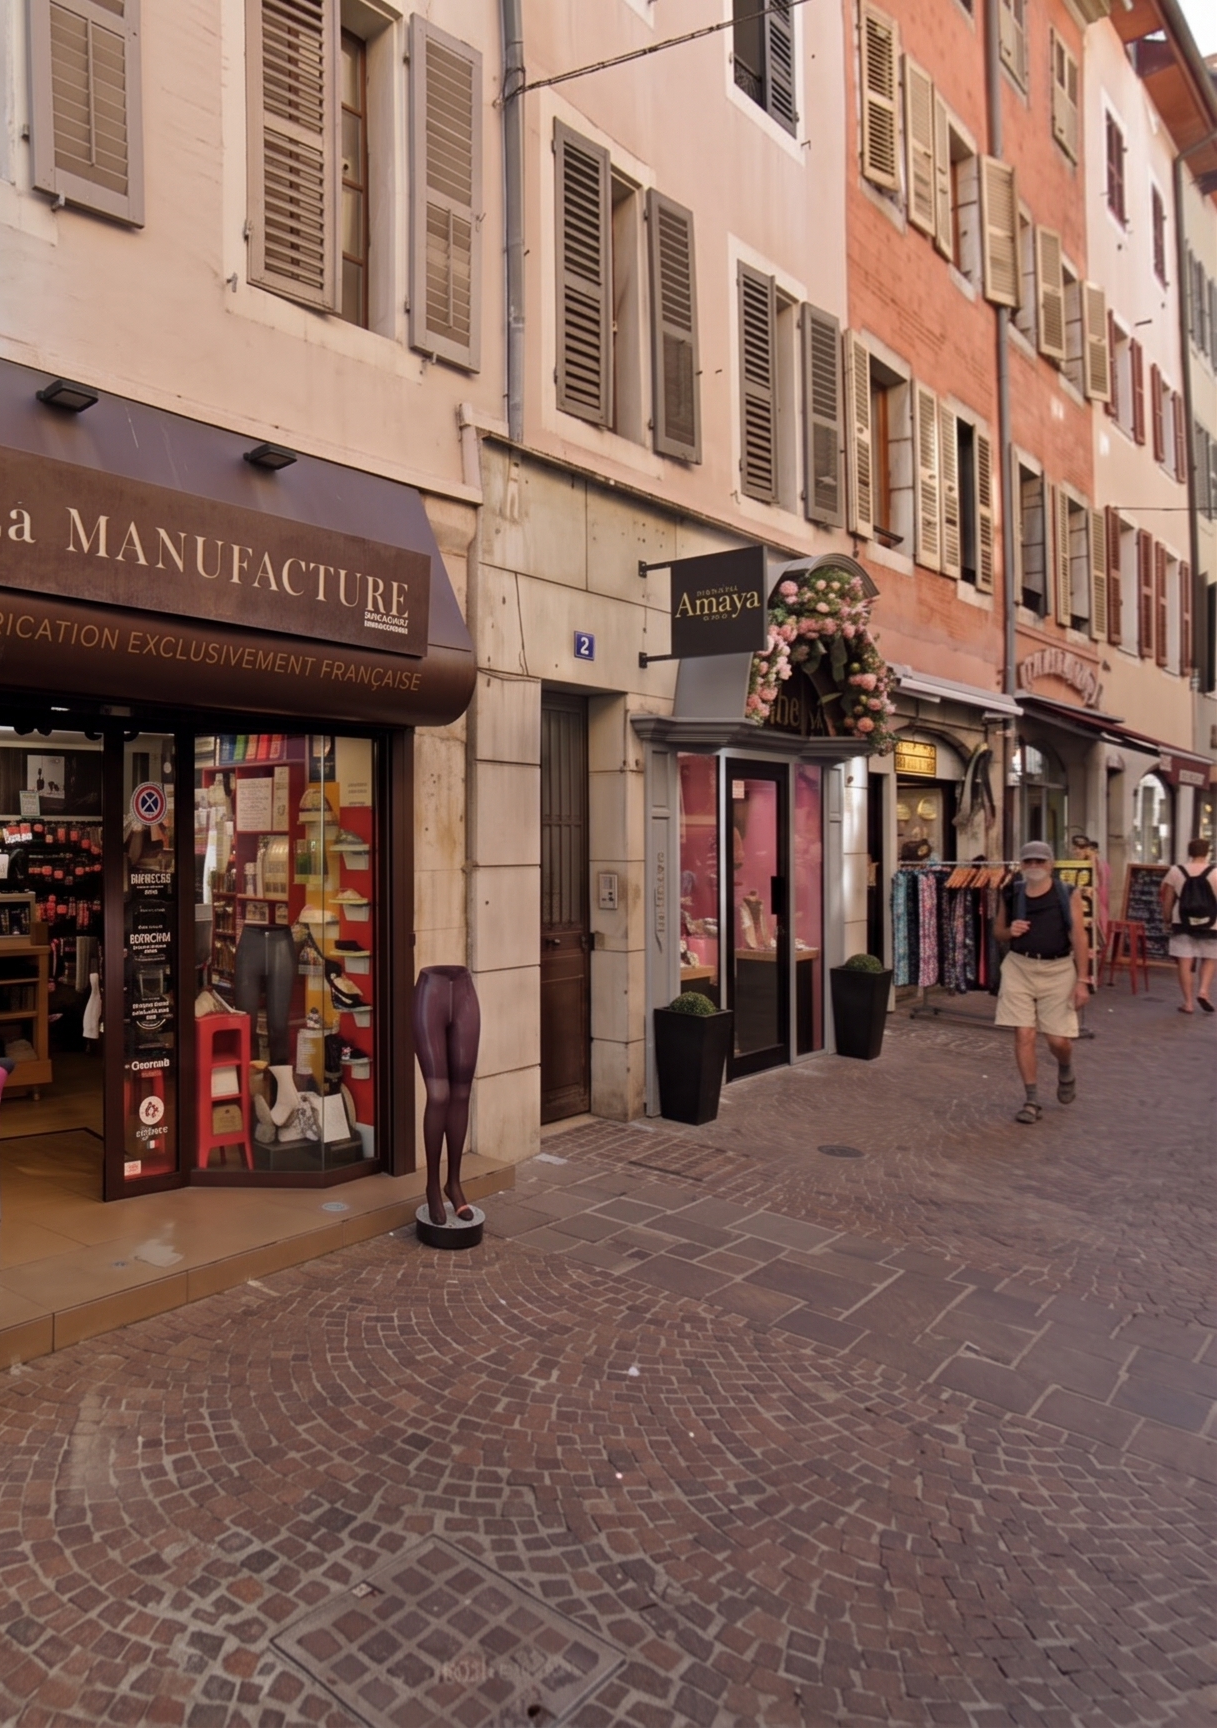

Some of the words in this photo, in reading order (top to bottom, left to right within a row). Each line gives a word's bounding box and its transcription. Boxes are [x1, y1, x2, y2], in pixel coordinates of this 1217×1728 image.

[65, 506, 409, 618] MANUFACTURE
[674, 589, 761, 618] Amaya
[128, 631, 316, 677] EXCLUSIVEMENT
[320, 659, 422, 692] FRANÇAISE
[580, 636, 590, 655] 2
